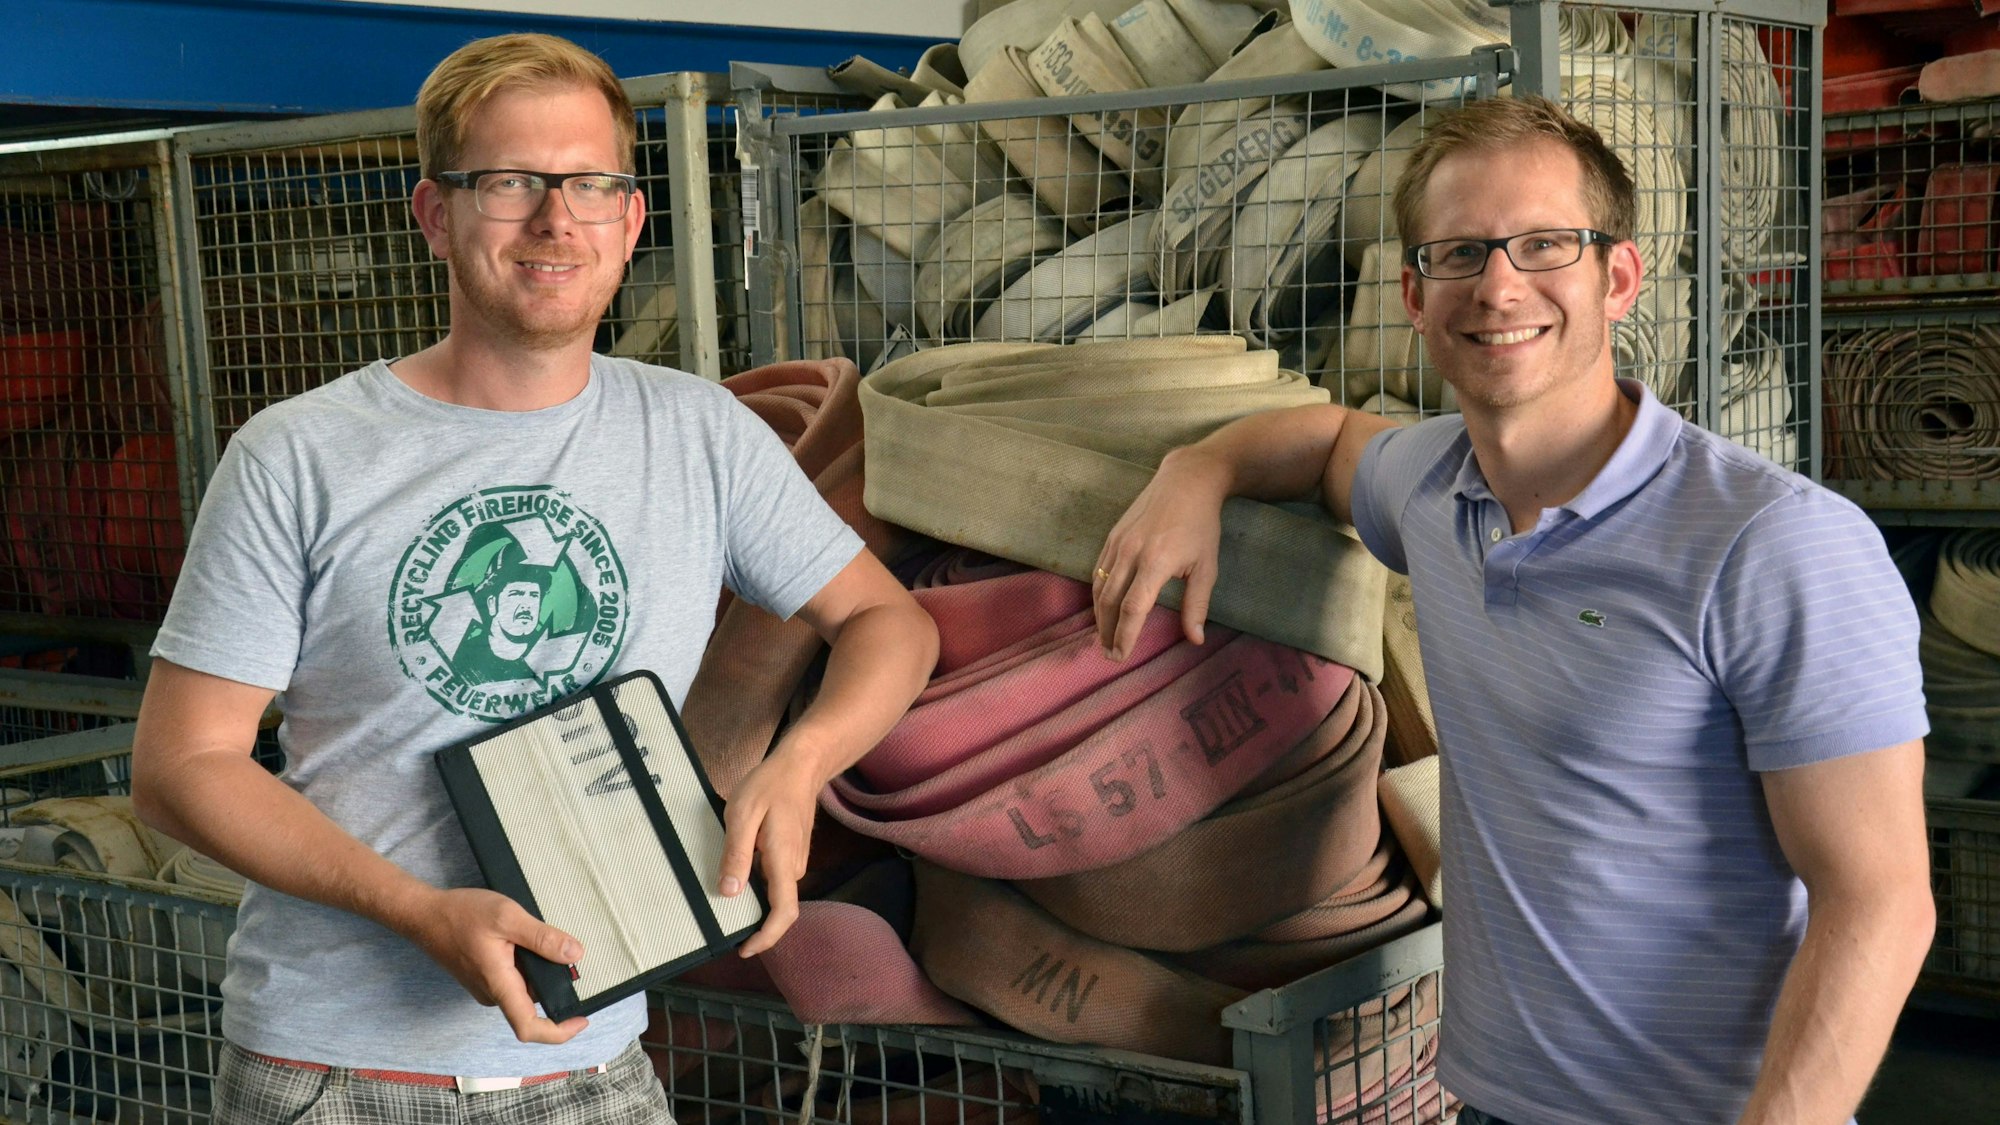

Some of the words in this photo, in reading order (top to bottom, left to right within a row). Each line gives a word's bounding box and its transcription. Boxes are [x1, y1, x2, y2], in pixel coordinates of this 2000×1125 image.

[1172, 120, 1297, 224] SEGEBERG
[459, 494, 575, 528] FIREHOSE
[401, 518, 461, 646] RECYCLING
[571, 519, 617, 587] SINCE
[592, 591, 620, 649] 2005
[425, 666, 582, 714] FEUERWEAR
[1010, 952, 1099, 1024] MN
